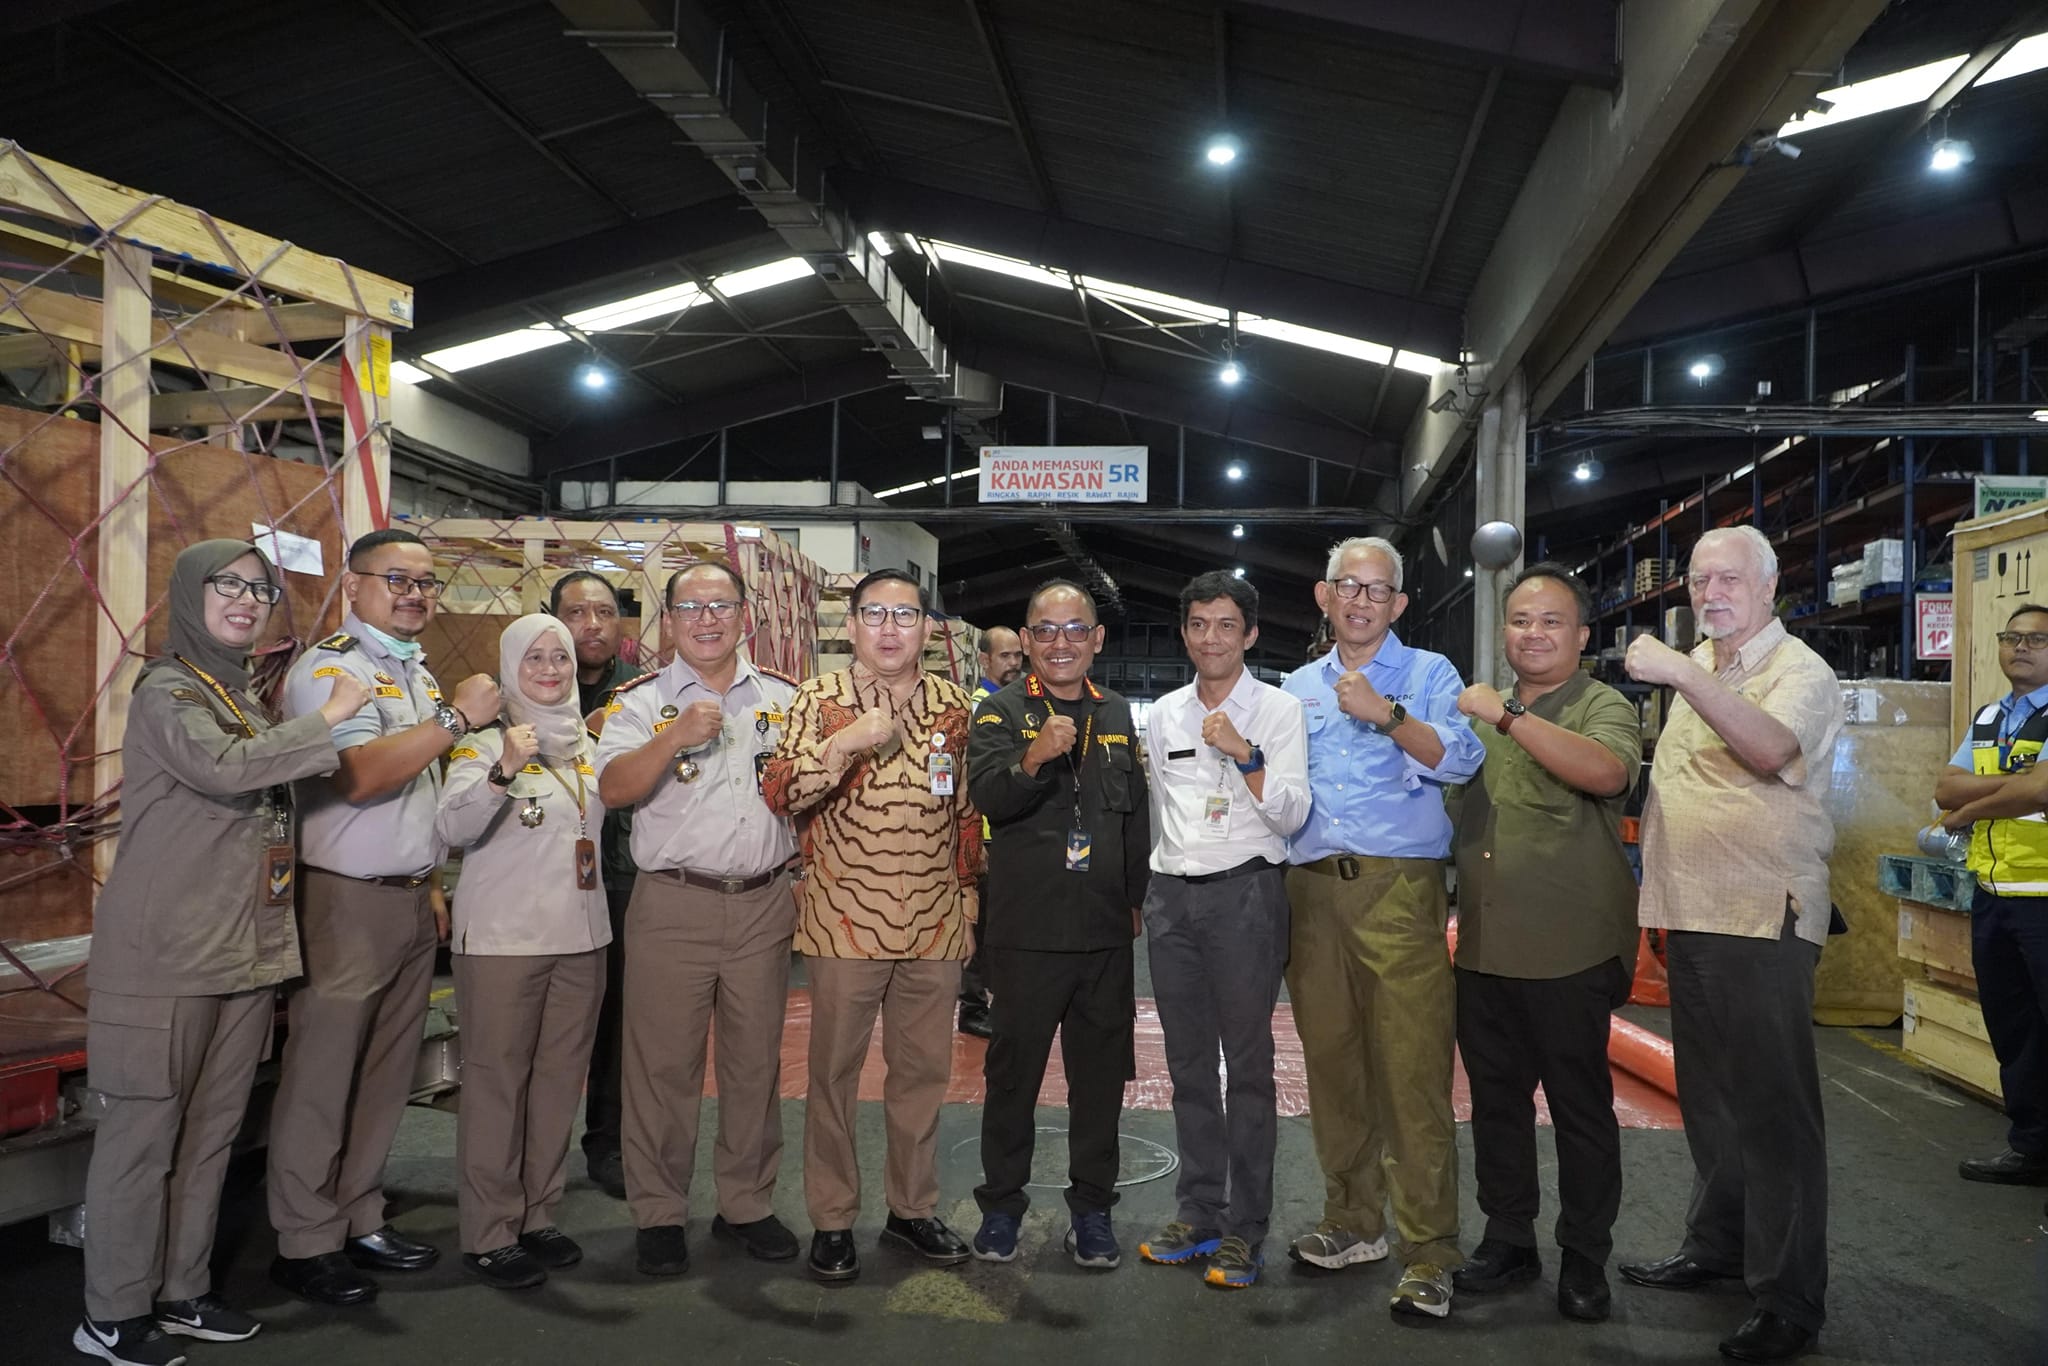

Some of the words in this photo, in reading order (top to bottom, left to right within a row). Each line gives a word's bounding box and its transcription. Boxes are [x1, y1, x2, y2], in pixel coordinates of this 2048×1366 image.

[992, 460, 1029, 471] ANDA
[1032, 460, 1103, 471] MEMASUKI
[1109, 464, 1139, 483] 5R
[991, 472, 1103, 490] KAWASAN
[987, 491, 1020, 499] RINGKAS
[1057, 491, 1079, 499] RESIK
[1086, 491, 1112, 499] RAWAT
[1117, 491, 1139, 500] RAJIN
[1922, 602, 1952, 613] FORK
